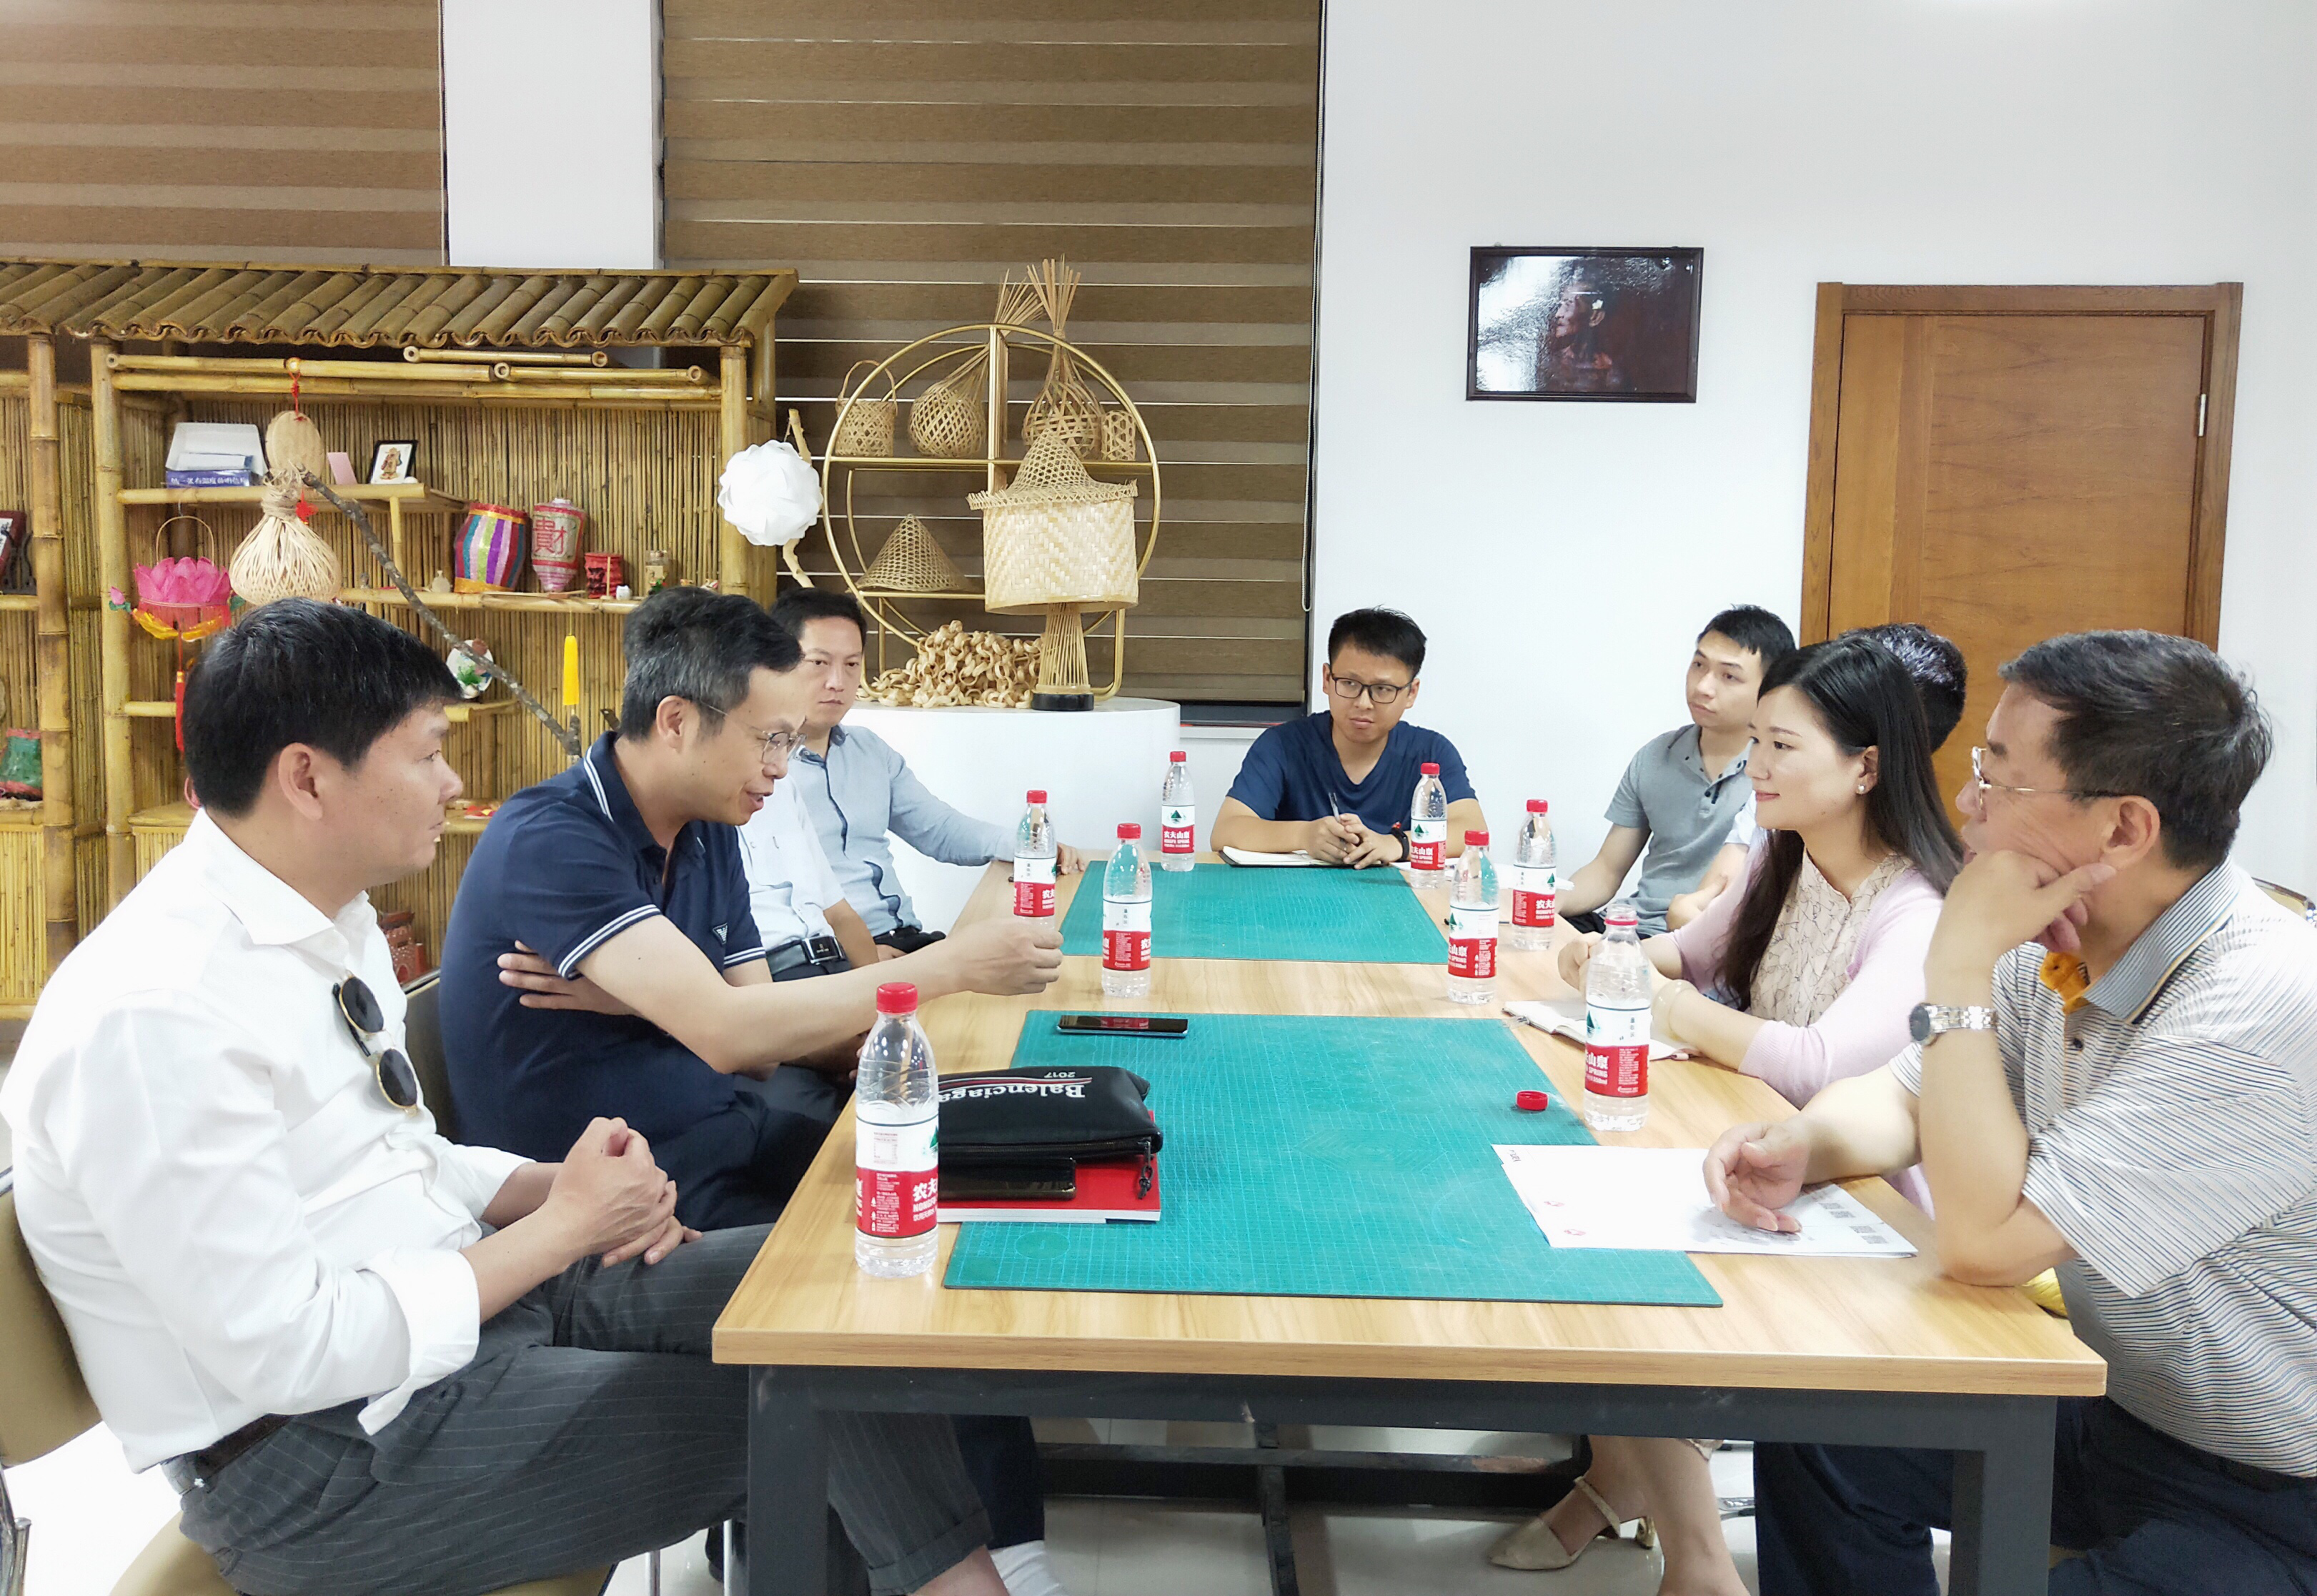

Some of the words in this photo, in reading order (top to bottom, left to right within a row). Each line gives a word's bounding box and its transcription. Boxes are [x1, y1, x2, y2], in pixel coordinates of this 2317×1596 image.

[1164, 831, 1190, 839] 农夫山泉
[1589, 1066, 1607, 1078] SPRING
[938, 1084, 1086, 1103] Balenciaga
